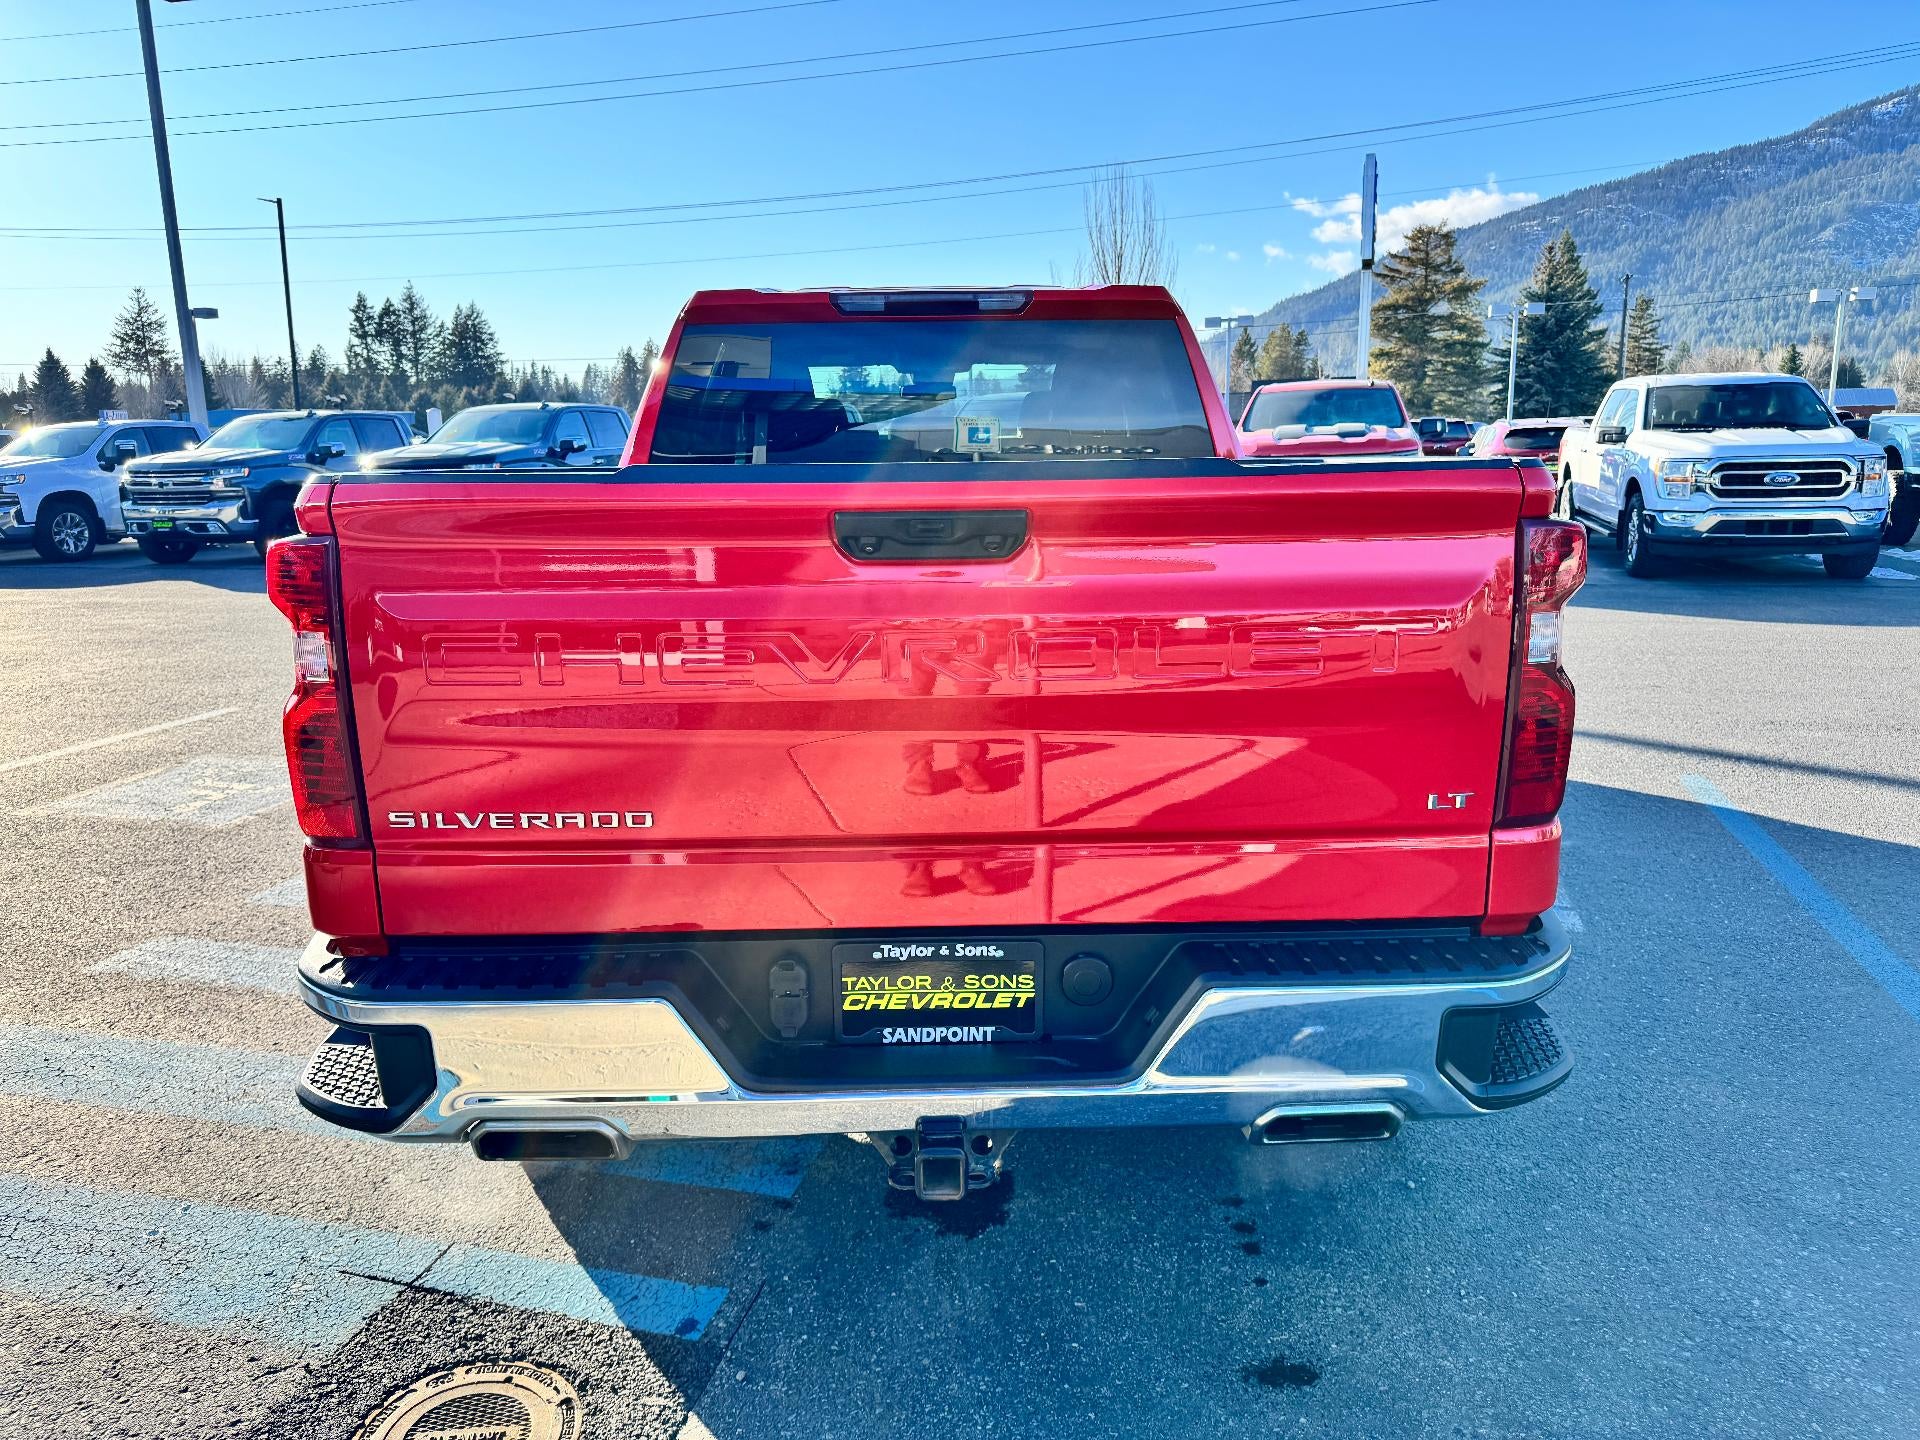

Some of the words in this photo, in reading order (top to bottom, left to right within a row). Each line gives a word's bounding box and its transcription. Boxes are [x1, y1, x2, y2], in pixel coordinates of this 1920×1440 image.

[421, 616, 1440, 687] CHEVROLET
[1427, 792, 1476, 810] LT
[388, 811, 655, 829] SILVERADO
[880, 944, 935, 961] Taylor
[939, 946, 949, 955] &
[954, 943, 997, 958] Sons
[841, 975, 932, 990] TAYLOR
[940, 976, 955, 992] &
[963, 974, 1035, 989] SONS
[842, 992, 1036, 1011] CHEVROLET
[882, 1026, 996, 1043] SANDPOINT
